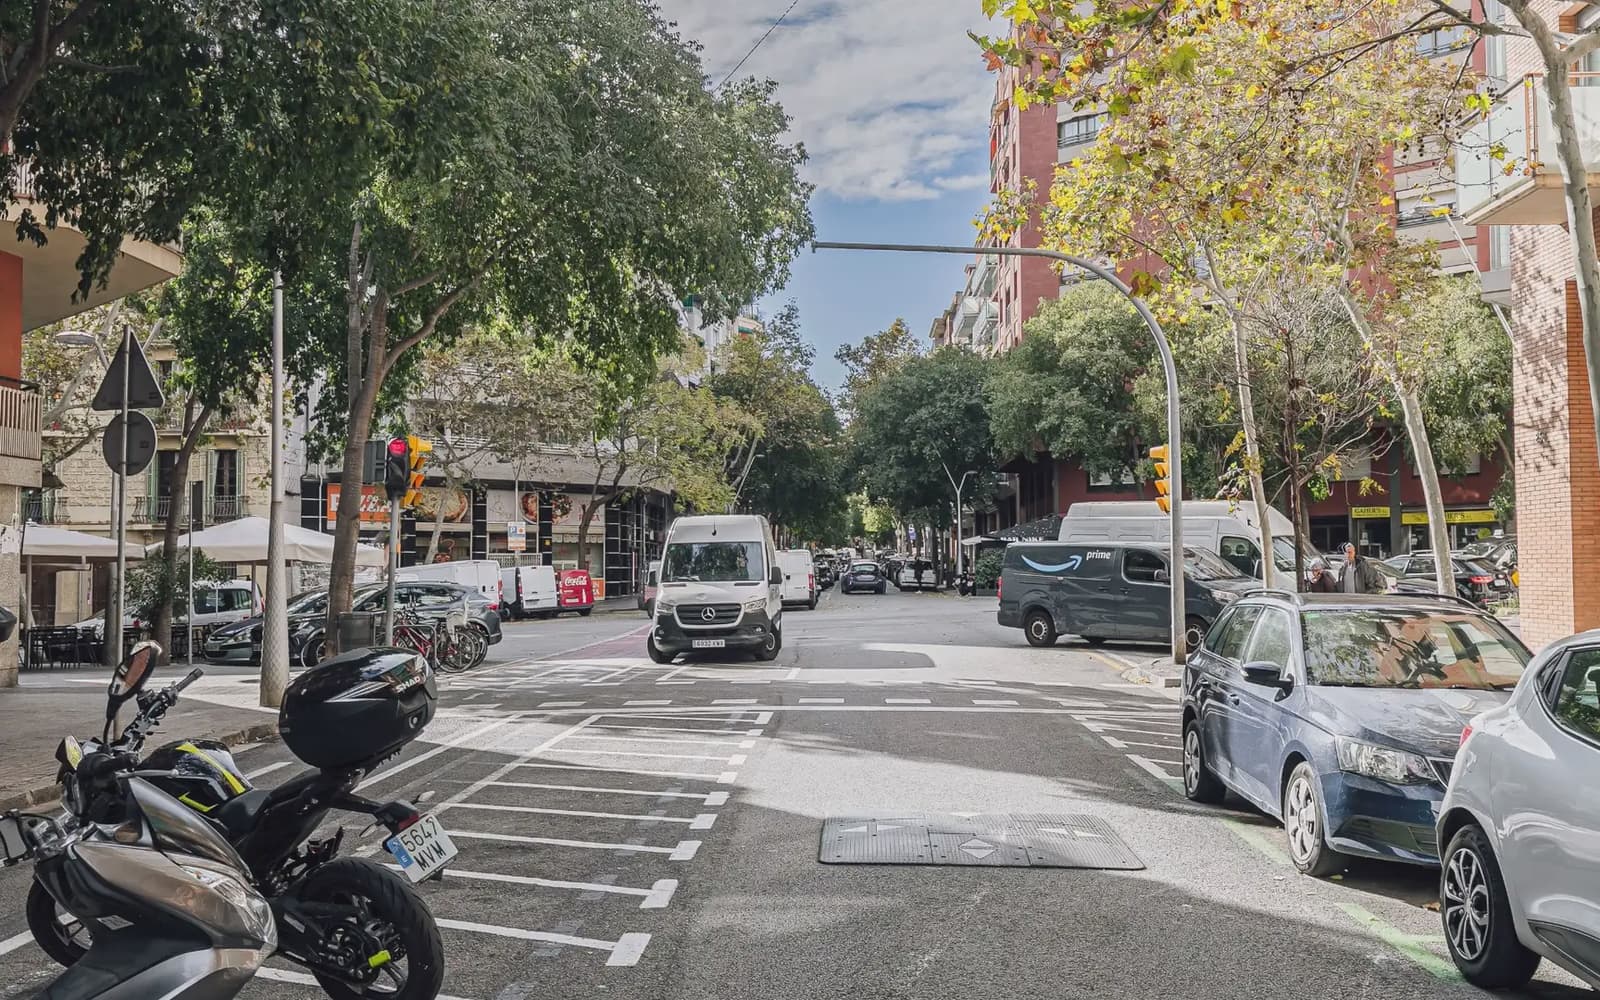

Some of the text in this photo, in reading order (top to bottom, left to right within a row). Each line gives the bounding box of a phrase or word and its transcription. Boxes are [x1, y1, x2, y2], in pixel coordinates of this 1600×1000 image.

[1086, 549, 1111, 561] prime
[395, 677, 421, 693] SHAD
[401, 816, 437, 852] 5647
[413, 840, 447, 871] MVM
